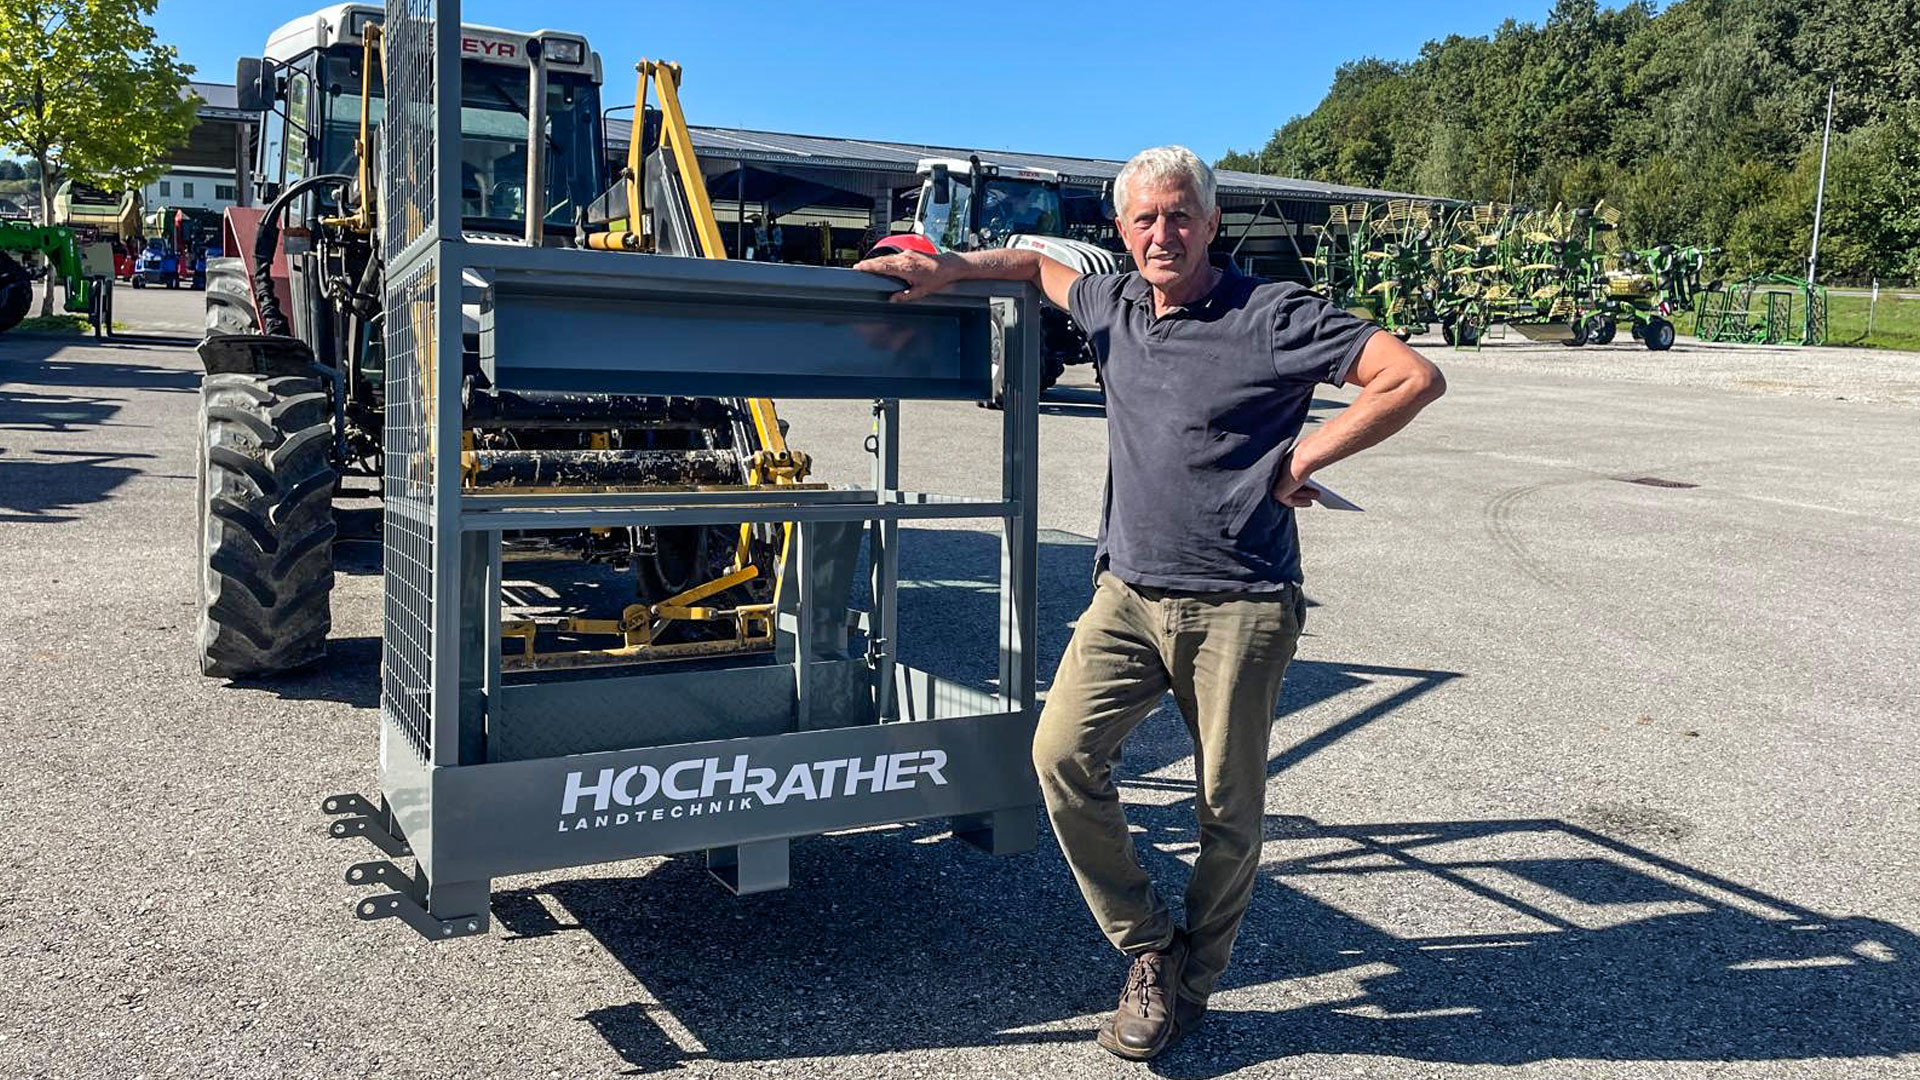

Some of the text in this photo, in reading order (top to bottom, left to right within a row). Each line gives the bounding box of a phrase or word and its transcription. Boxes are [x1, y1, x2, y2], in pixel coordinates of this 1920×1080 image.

[462, 37, 515, 57] EYR
[561, 749, 948, 815] HOCHRATHER
[558, 797, 752, 832] LANDTECHNIK
